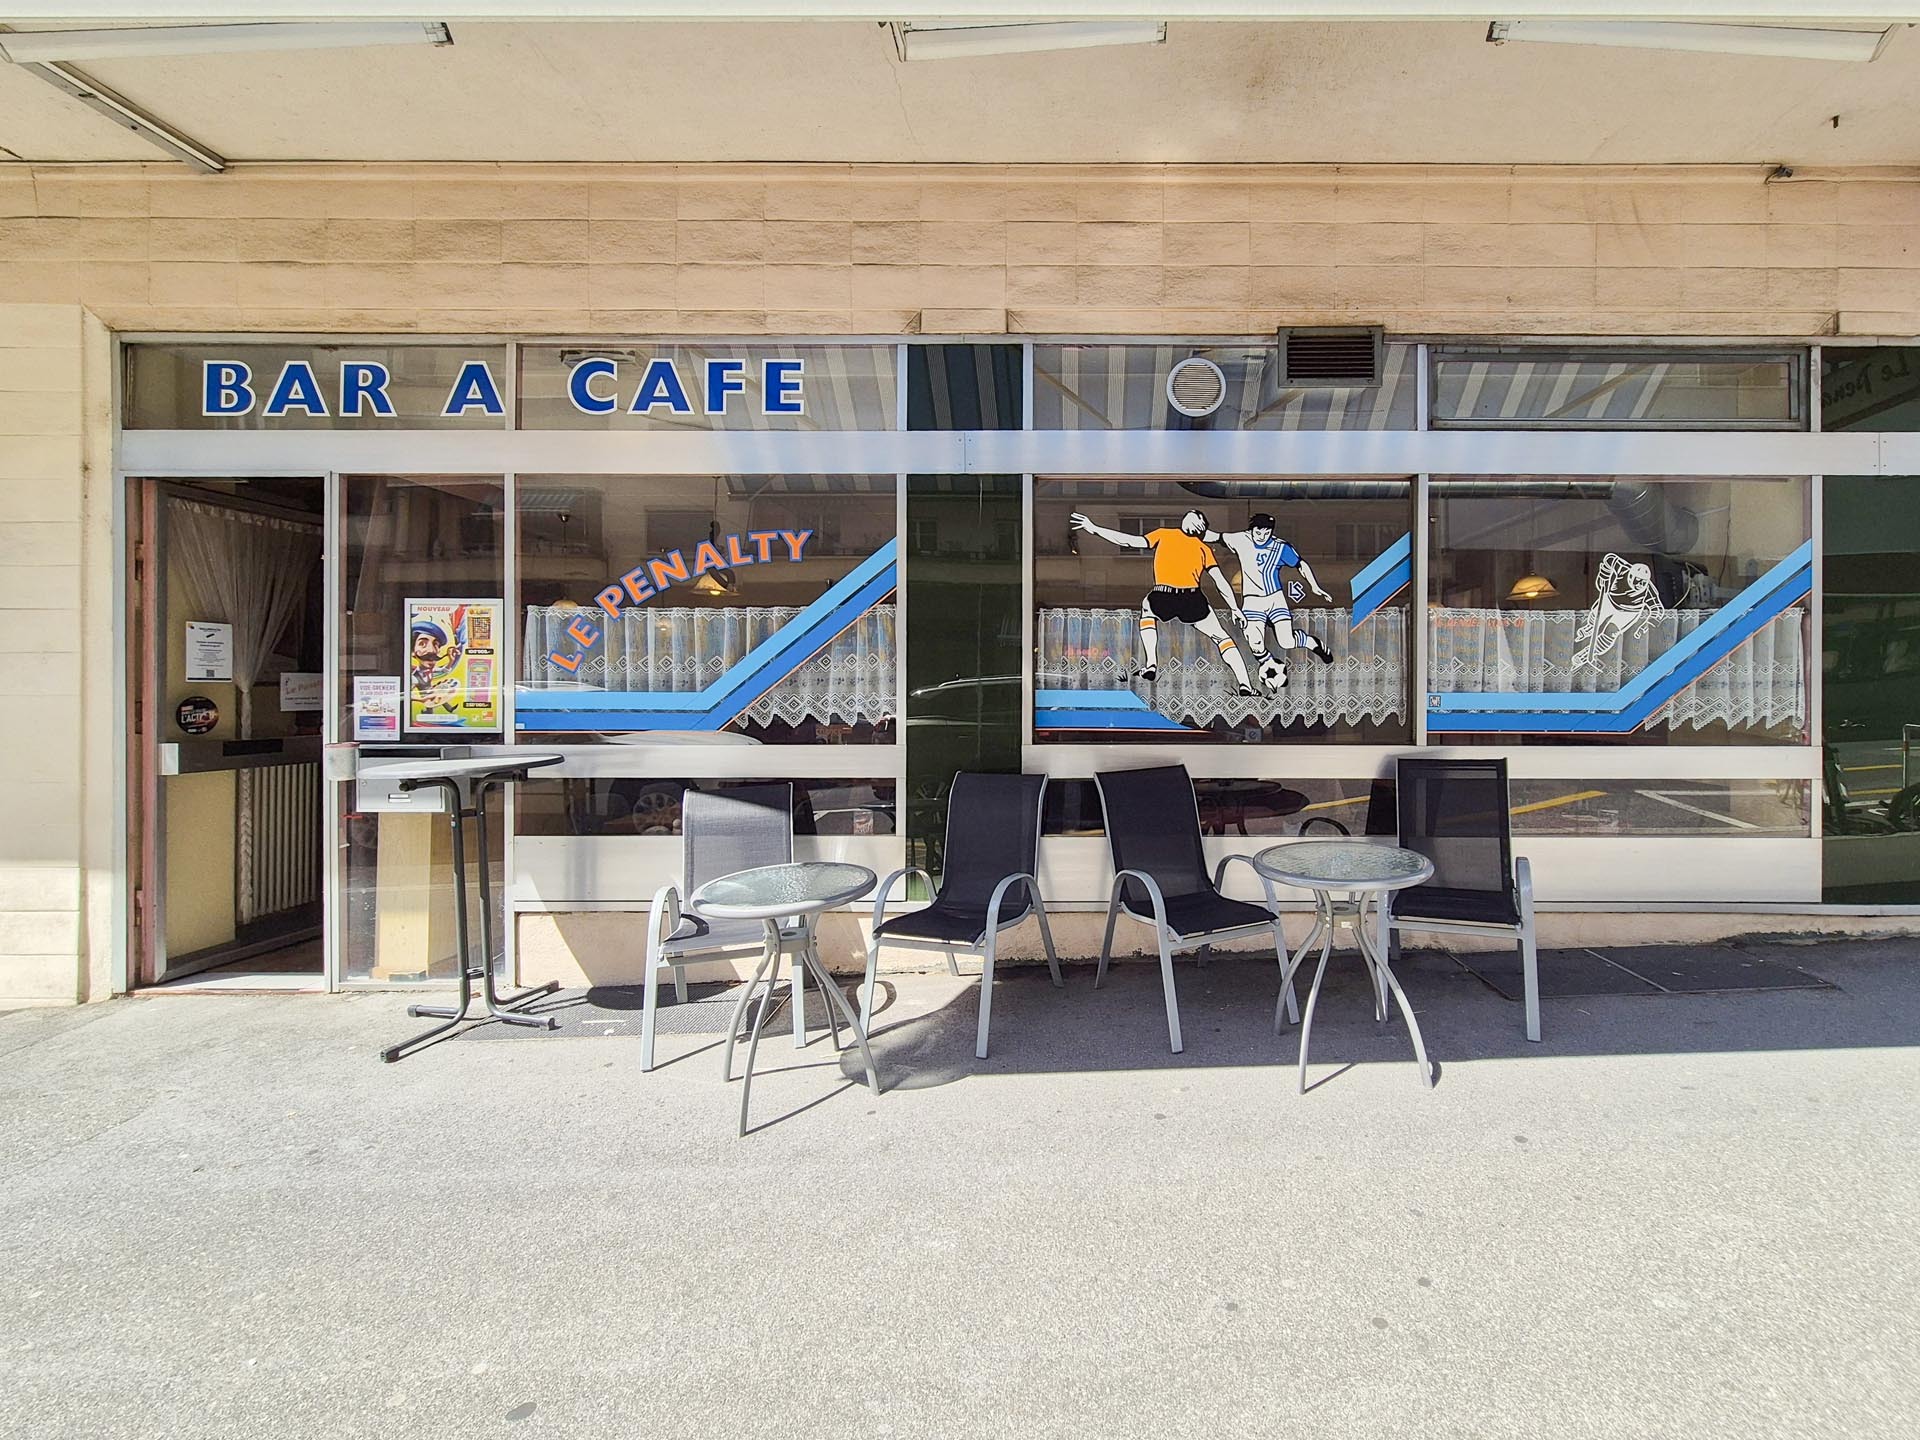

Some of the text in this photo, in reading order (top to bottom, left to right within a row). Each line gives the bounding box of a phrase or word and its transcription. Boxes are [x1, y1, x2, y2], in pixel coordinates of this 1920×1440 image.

[202, 357, 806, 418] BAR A CAFE
[548, 529, 815, 675] LE PENALTY
